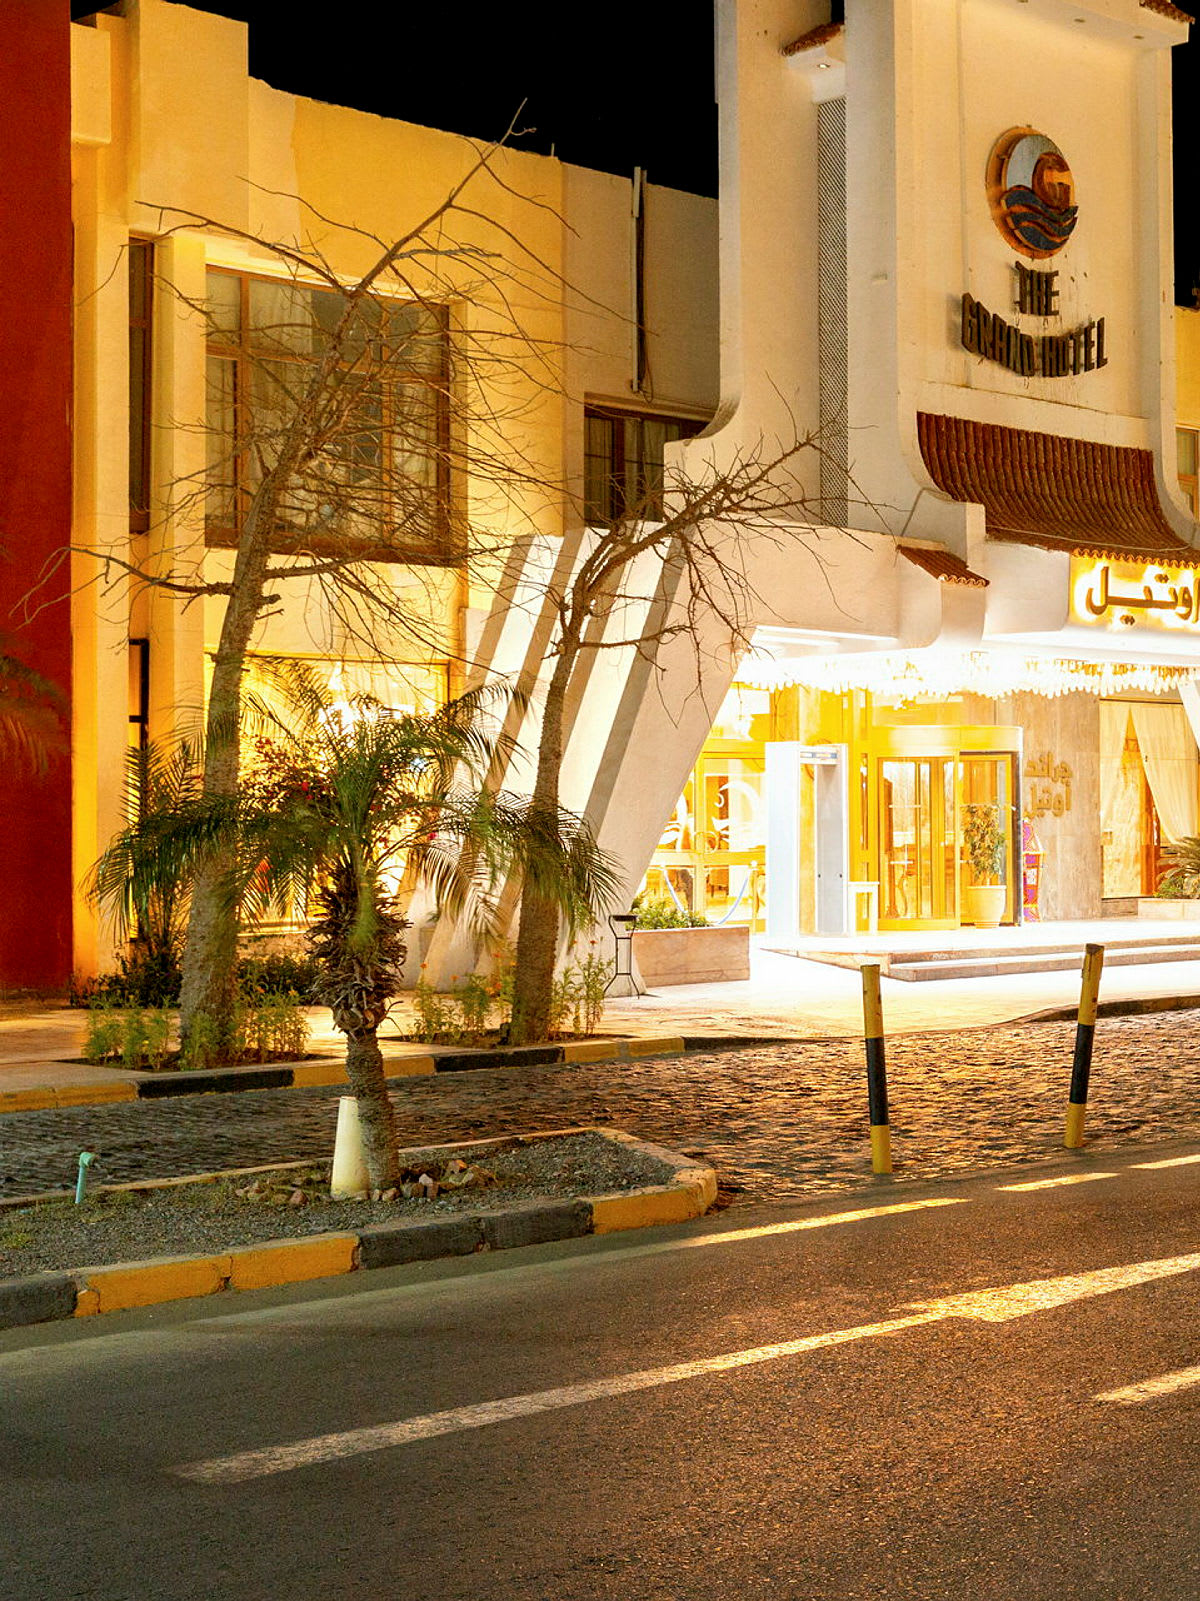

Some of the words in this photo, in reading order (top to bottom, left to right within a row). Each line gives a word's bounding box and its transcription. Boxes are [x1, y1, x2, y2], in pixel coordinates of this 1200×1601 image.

[1015, 261, 1059, 316] THE
[962, 292, 1035, 378] GRAND
[1042, 317, 1109, 378] HOTEL
